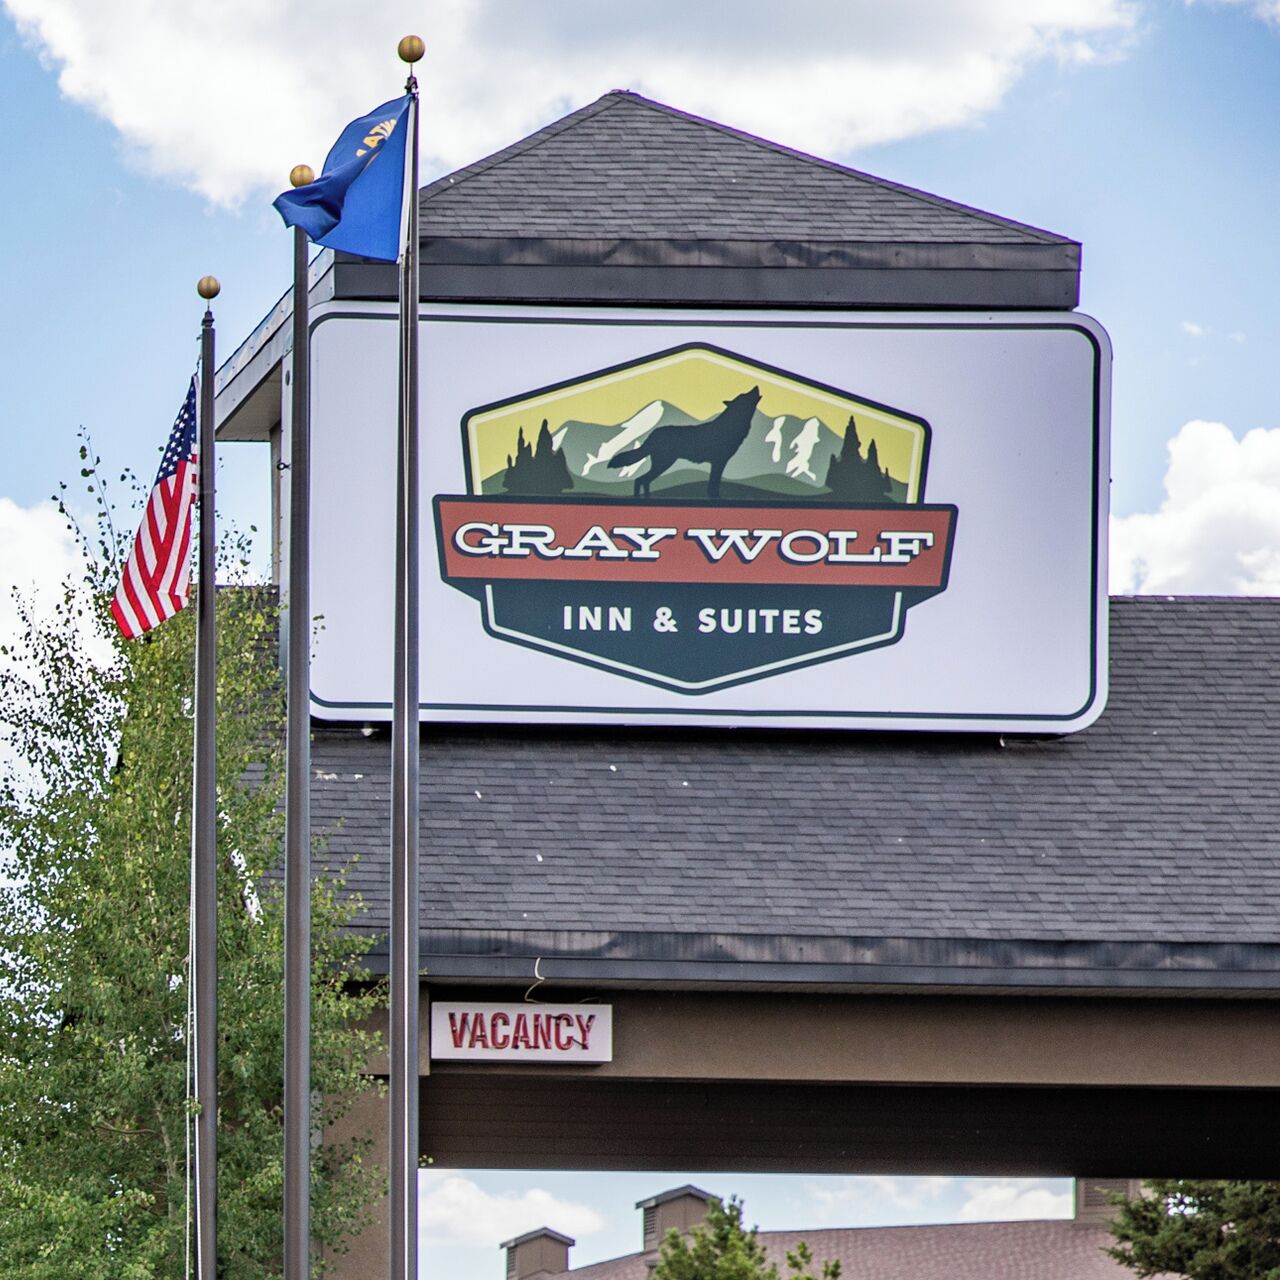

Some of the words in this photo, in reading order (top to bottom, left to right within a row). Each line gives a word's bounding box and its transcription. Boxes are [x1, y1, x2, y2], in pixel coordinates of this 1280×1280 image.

[454, 522, 677, 560] GRAY
[687, 528, 935, 566] WOLF
[563, 605, 632, 632] INN
[653, 606, 679, 633] &
[698, 607, 823, 635] SUITES
[448, 1012, 596, 1050] VACANCY
